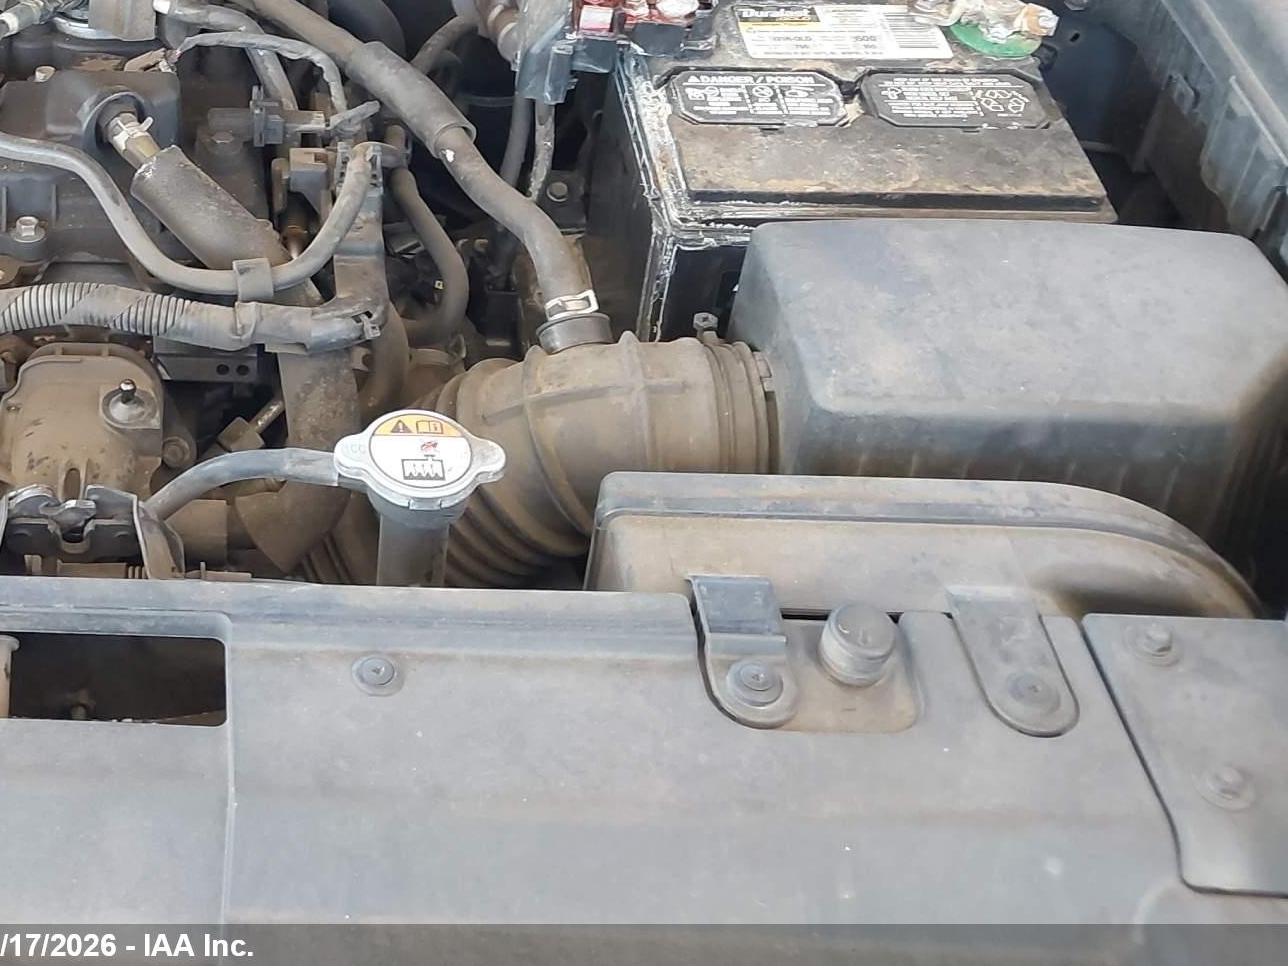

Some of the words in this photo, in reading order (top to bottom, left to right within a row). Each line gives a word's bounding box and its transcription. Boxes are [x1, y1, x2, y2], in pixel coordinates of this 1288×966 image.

[742, 8, 810, 18] Duralast
[700, 76, 754, 84] DANGER
[765, 76, 815, 84] POISON
